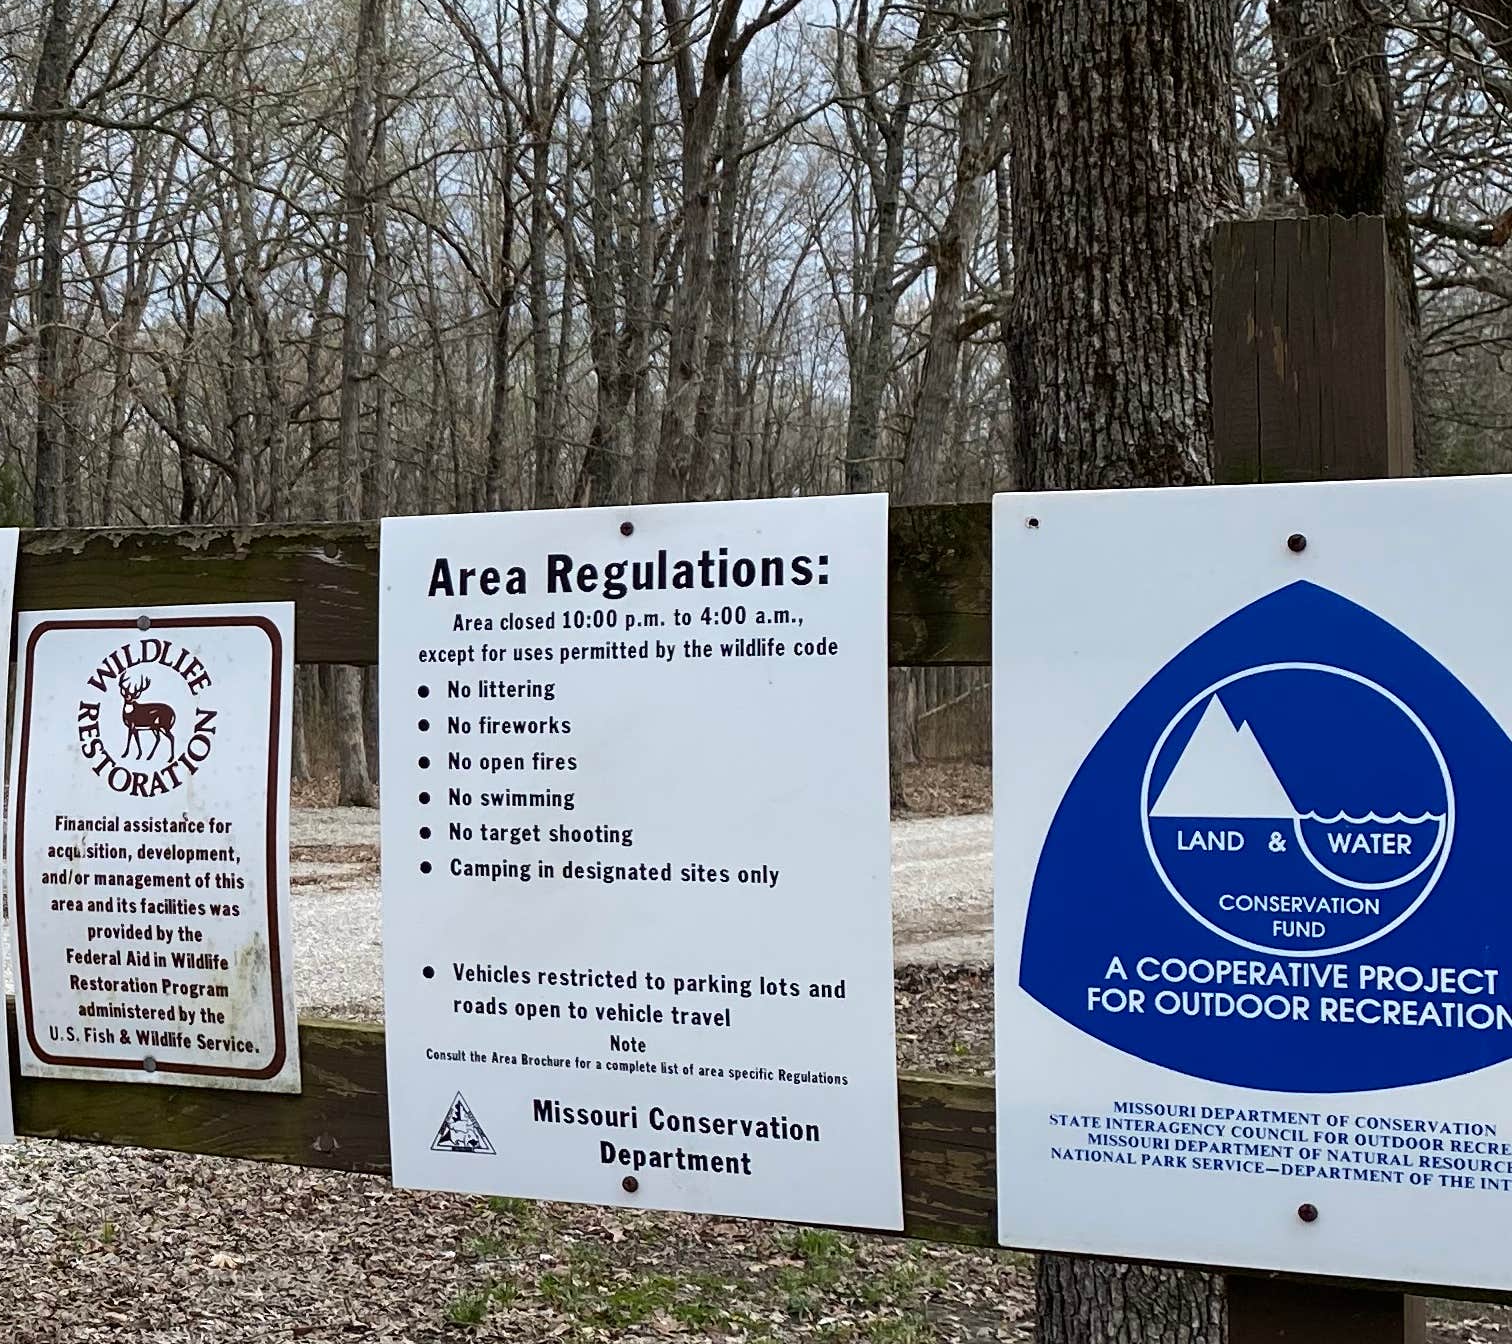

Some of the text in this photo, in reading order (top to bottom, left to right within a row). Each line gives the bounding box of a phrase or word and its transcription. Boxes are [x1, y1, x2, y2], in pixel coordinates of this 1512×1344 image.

[428, 547, 828, 600] Area Regulations:
[453, 606, 803, 632] Area closed 10:00 p.m. to 4:00 a.m.,
[88, 639, 212, 695] WILDLIFE
[448, 679, 556, 701] No littering
[448, 716, 571, 734] No fireworks
[78, 701, 218, 797] RESTORATION
[448, 752, 577, 774] No open fires
[448, 788, 575, 810] No swimming
[55, 815, 232, 834] Financial assistance for
[449, 822, 633, 847] No target shooting
[1178, 830, 1412, 854] LAND & WATER
[1219, 894, 1380, 915] CONSERVATION
[1273, 920, 1326, 938] FUND
[66, 948, 229, 970] Federal Aid in Wildlife
[70, 974, 229, 999] Restoration Program
[1105, 956, 1498, 994] A COOPERATIVE PROJECT
[1088, 987, 1512, 1030] FOR OUTDOOR RECREATION
[84, 1027, 115, 1044] Fish
[120, 1028, 132, 1045] &
[136, 1029, 192, 1049] Wildlife
[196, 1034, 260, 1054] Service.
[426, 1048, 848, 1086] Consult the Area Brochure for a complete list of area specific Regulations
[533, 1099, 820, 1142] Missouri Conservation
[1114, 1101, 1496, 1136] MISSOURI DEPARTMENT OF CONSERVATION
[1049, 1114, 1101, 1128] STATE
[1106, 1117, 1226, 1137] INTERAGENCY
[1231, 1126, 1308, 1142] COUNCIL
[1314, 1131, 1349, 1145] FOR
[1354, 1134, 1444, 1151] OUTDOOR
[600, 1140, 752, 1176] Department
[1088, 1133, 1169, 1150] MISSOURI
[1175, 1139, 1294, 1158] DEPARTMENT
[1299, 1147, 1322, 1160] OF
[1327, 1149, 1413, 1167] NATURAL
[1051, 1147, 1136, 1164] NATIONAL
[1141, 1154, 1187, 1168] PARK
[1409, 1172, 1433, 1186] OF
[1438, 1174, 1475, 1189] THE
